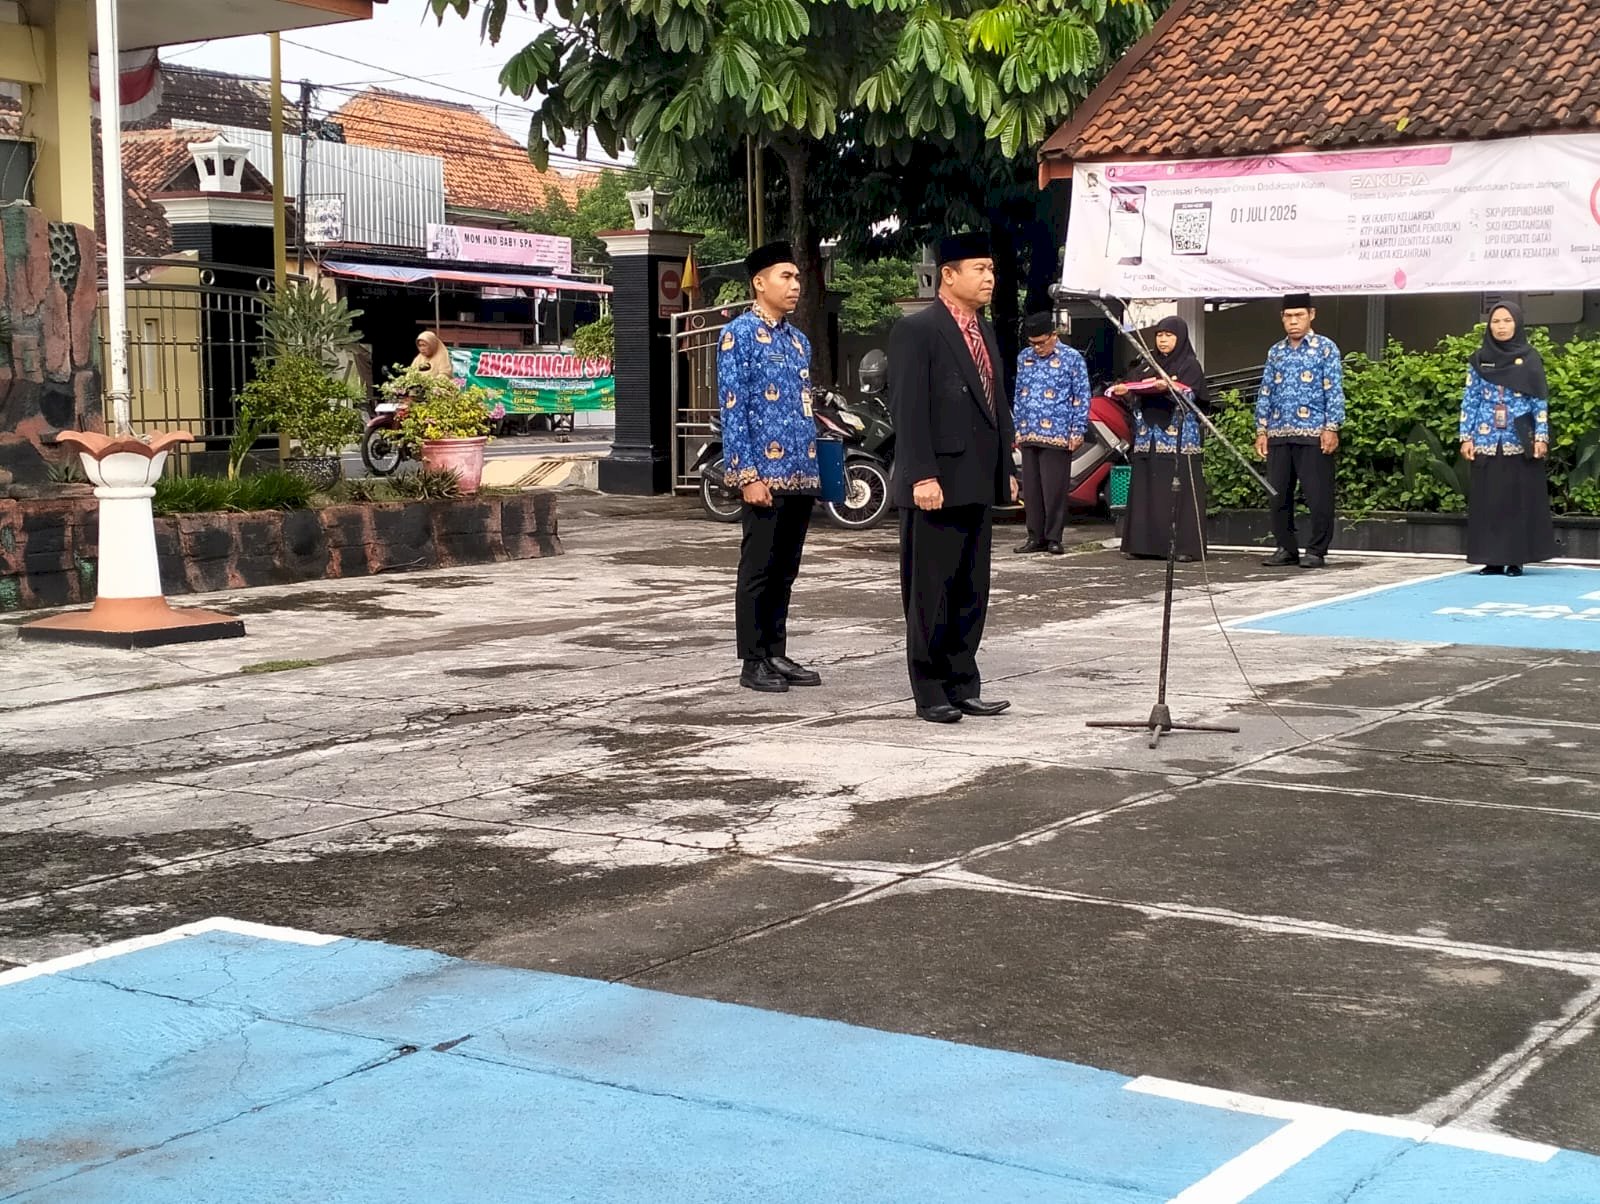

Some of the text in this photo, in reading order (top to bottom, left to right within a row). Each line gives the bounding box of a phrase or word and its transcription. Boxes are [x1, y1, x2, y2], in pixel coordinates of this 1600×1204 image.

[1351, 173, 1429, 189] SAKURA
[1230, 205, 1297, 223] 01 JULI 2025
[464, 233, 532, 249] MOM AND BABY SPA
